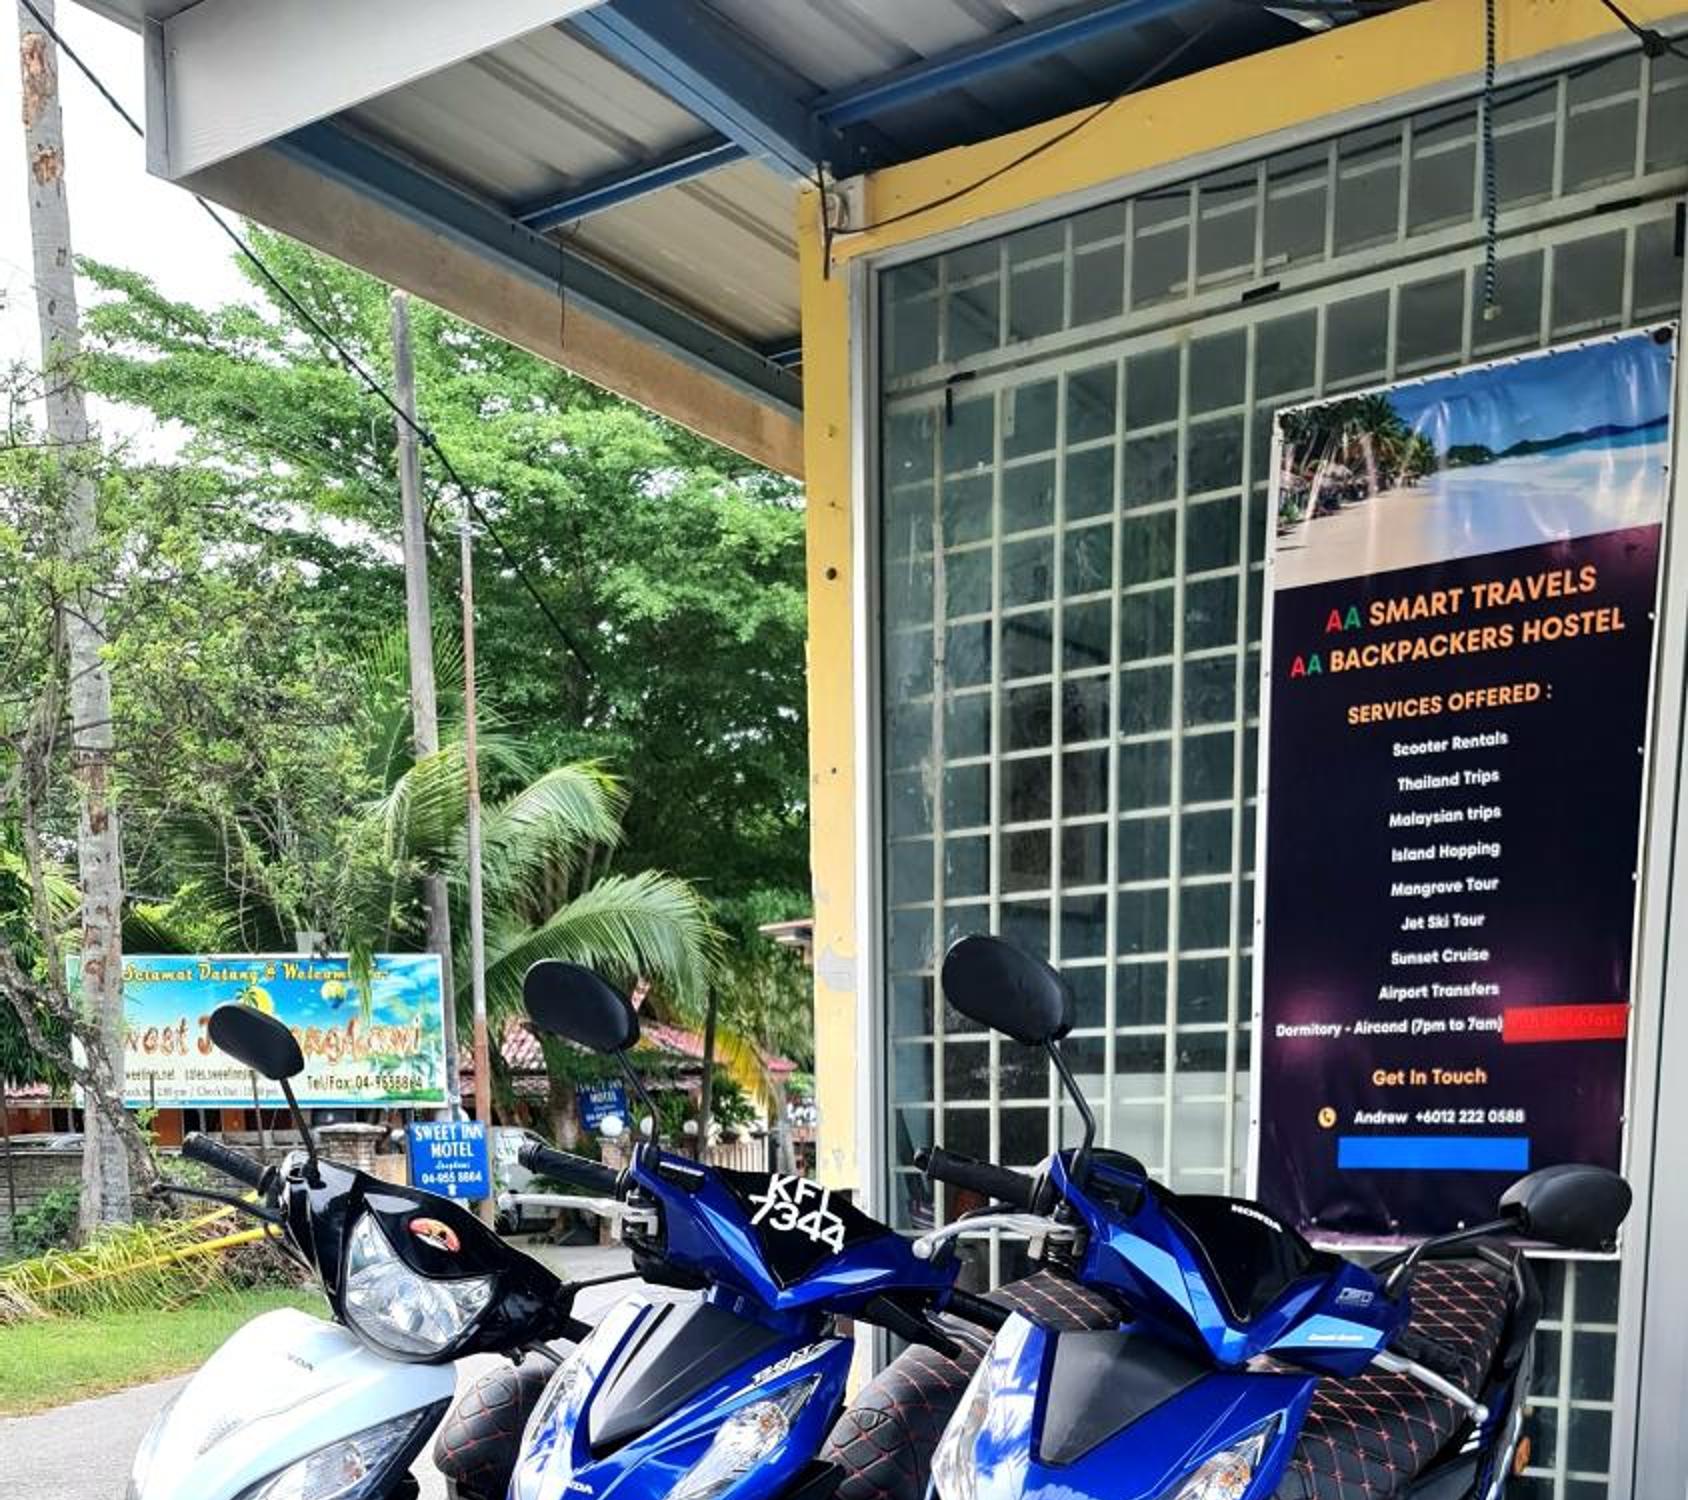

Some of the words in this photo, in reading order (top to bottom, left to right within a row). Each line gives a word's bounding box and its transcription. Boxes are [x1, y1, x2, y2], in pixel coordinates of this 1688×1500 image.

[1326, 608, 1360, 631] AA
[1370, 589, 1463, 625] SMART
[1472, 566, 1598, 610] TRAVELS
[1291, 655, 1321, 677] AA
[1330, 624, 1514, 672] BACKPACKERS
[1523, 608, 1624, 642] HOSTEL
[1349, 696, 1441, 724] SERVICES
[1448, 683, 1540, 710] OFFERED
[1394, 740, 1448, 756] Scooter
[1452, 731, 1508, 749] Rentals
[1398, 772, 1459, 791] Thailand
[1464, 769, 1499, 786] Trips
[1389, 809, 1463, 827] Malaysian
[1468, 805, 1501, 821] trips
[1392, 845, 1435, 862] Island
[1440, 841, 1500, 860] Hopping
[1391, 882, 1463, 898] Mangrove
[1466, 877, 1499, 891] Tour
[1401, 917, 1424, 930] Jet
[1428, 914, 1449, 928] Ski
[1453, 913, 1485, 926] Tour
[1392, 951, 1439, 965] Sunset
[1442, 948, 1489, 962] Cruise
[284, 962, 350, 980] Welcom
[1379, 986, 1428, 1002] Airport
[1432, 982, 1500, 997] Transfers
[1276, 1021, 1342, 1040] Dormitory
[1354, 1019, 1408, 1034] Aircond
[1412, 1019, 1446, 1034] (7pm
[1449, 1019, 1465, 1031] to
[1468, 1016, 1503, 1033] 7am)
[1373, 1070, 1404, 1085] Get
[1410, 1070, 1427, 1084] In
[1432, 1068, 1486, 1084] Touch
[1354, 1111, 1408, 1124] Andrew
[1416, 1110, 1455, 1123] +6012
[1459, 1109, 1485, 1123] 222
[1488, 1109, 1524, 1123] 0588
[415, 1124, 456, 1141] SWEET
[1231, 1204, 1283, 1233] HONDA
